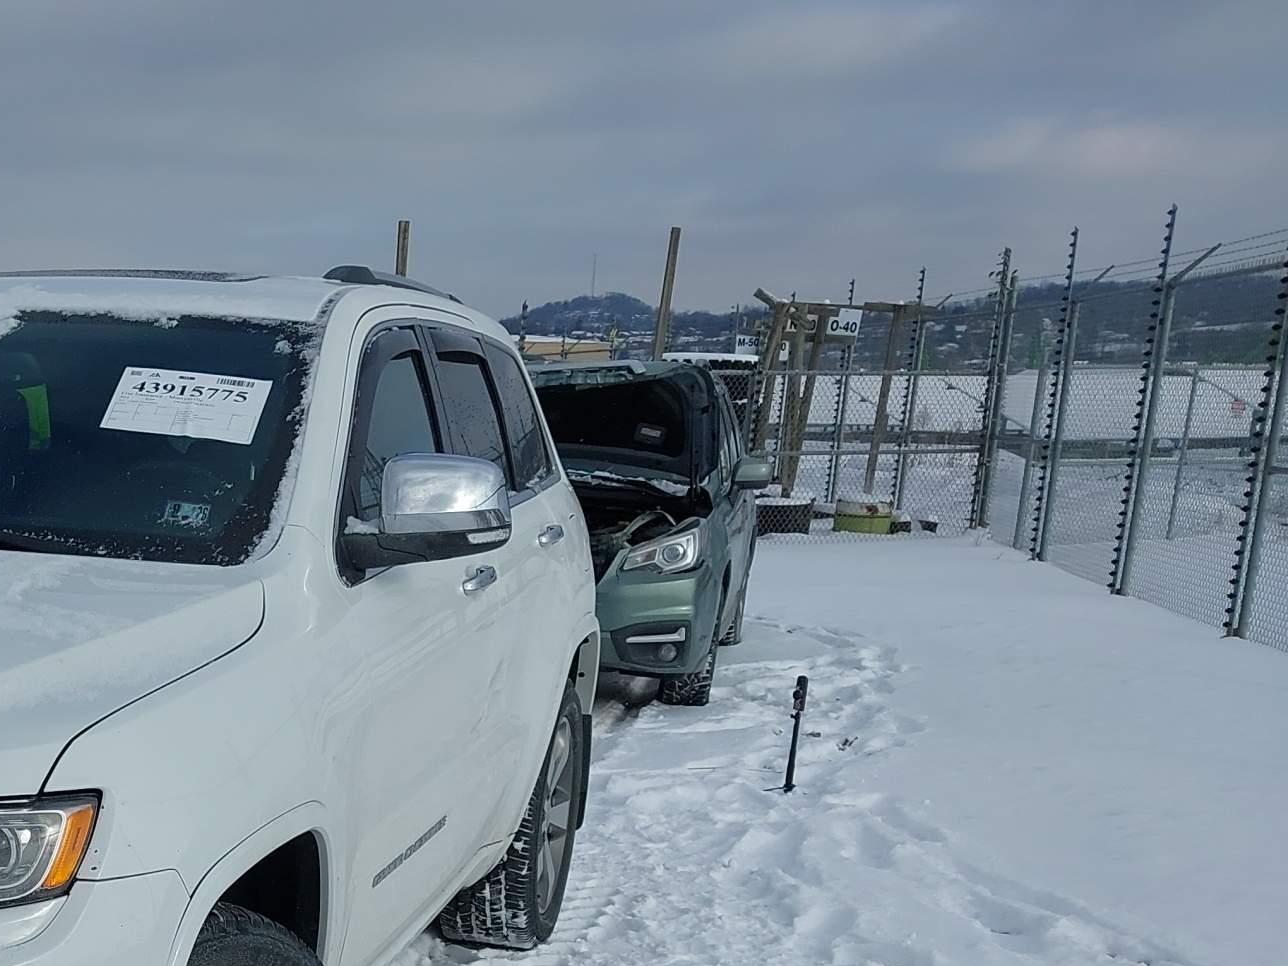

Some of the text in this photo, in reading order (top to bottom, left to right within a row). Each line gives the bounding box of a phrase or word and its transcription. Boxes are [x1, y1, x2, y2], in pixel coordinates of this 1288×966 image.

[830, 319, 858, 333] O-40
[737, 337, 760, 347] M-50
[132, 380, 249, 403] 43915775
